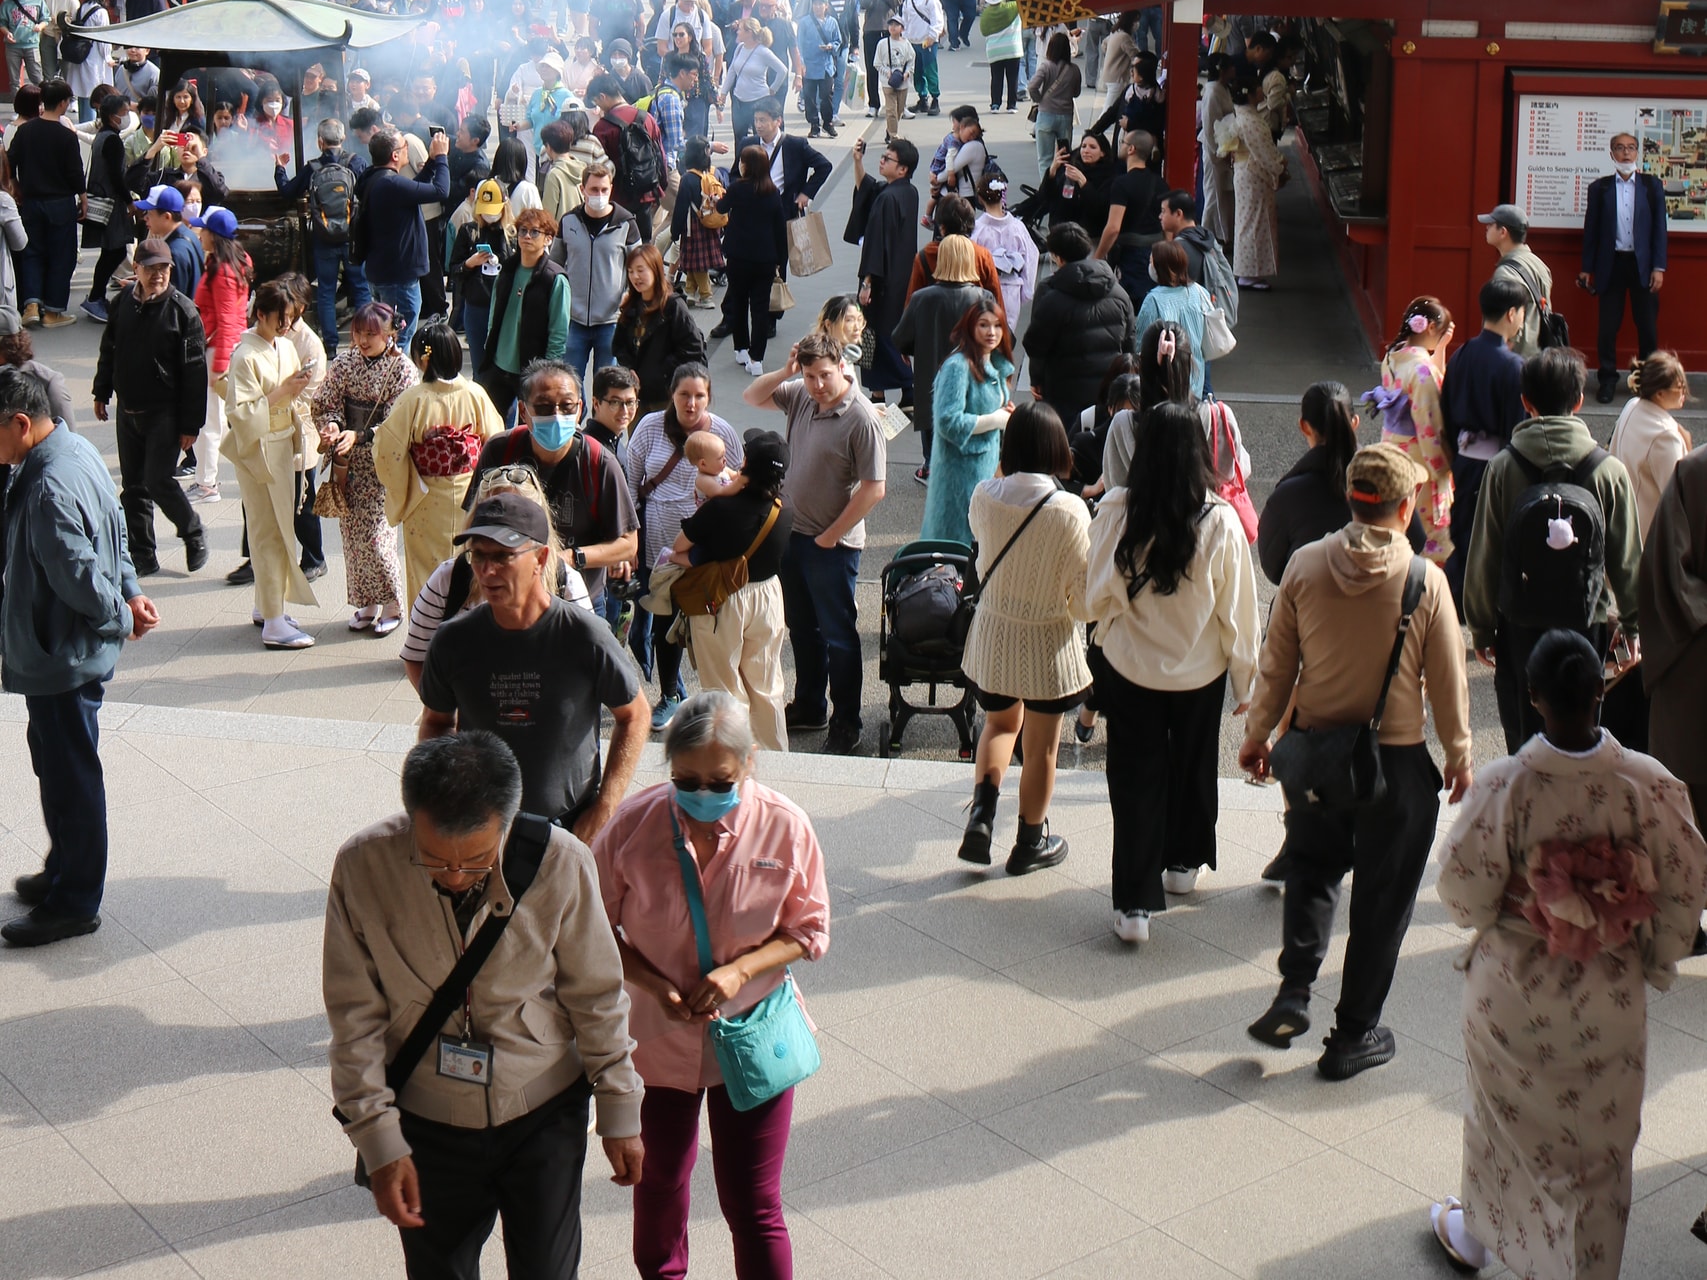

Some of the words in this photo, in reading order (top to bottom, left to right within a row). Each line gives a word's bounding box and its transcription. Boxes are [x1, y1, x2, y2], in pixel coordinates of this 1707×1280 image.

[490, 672, 497, 680] A
[498, 673, 522, 682] quaint
[523, 672, 541, 680] little
[490, 681, 521, 690] drinking
[514, 689, 541, 699] fishing
